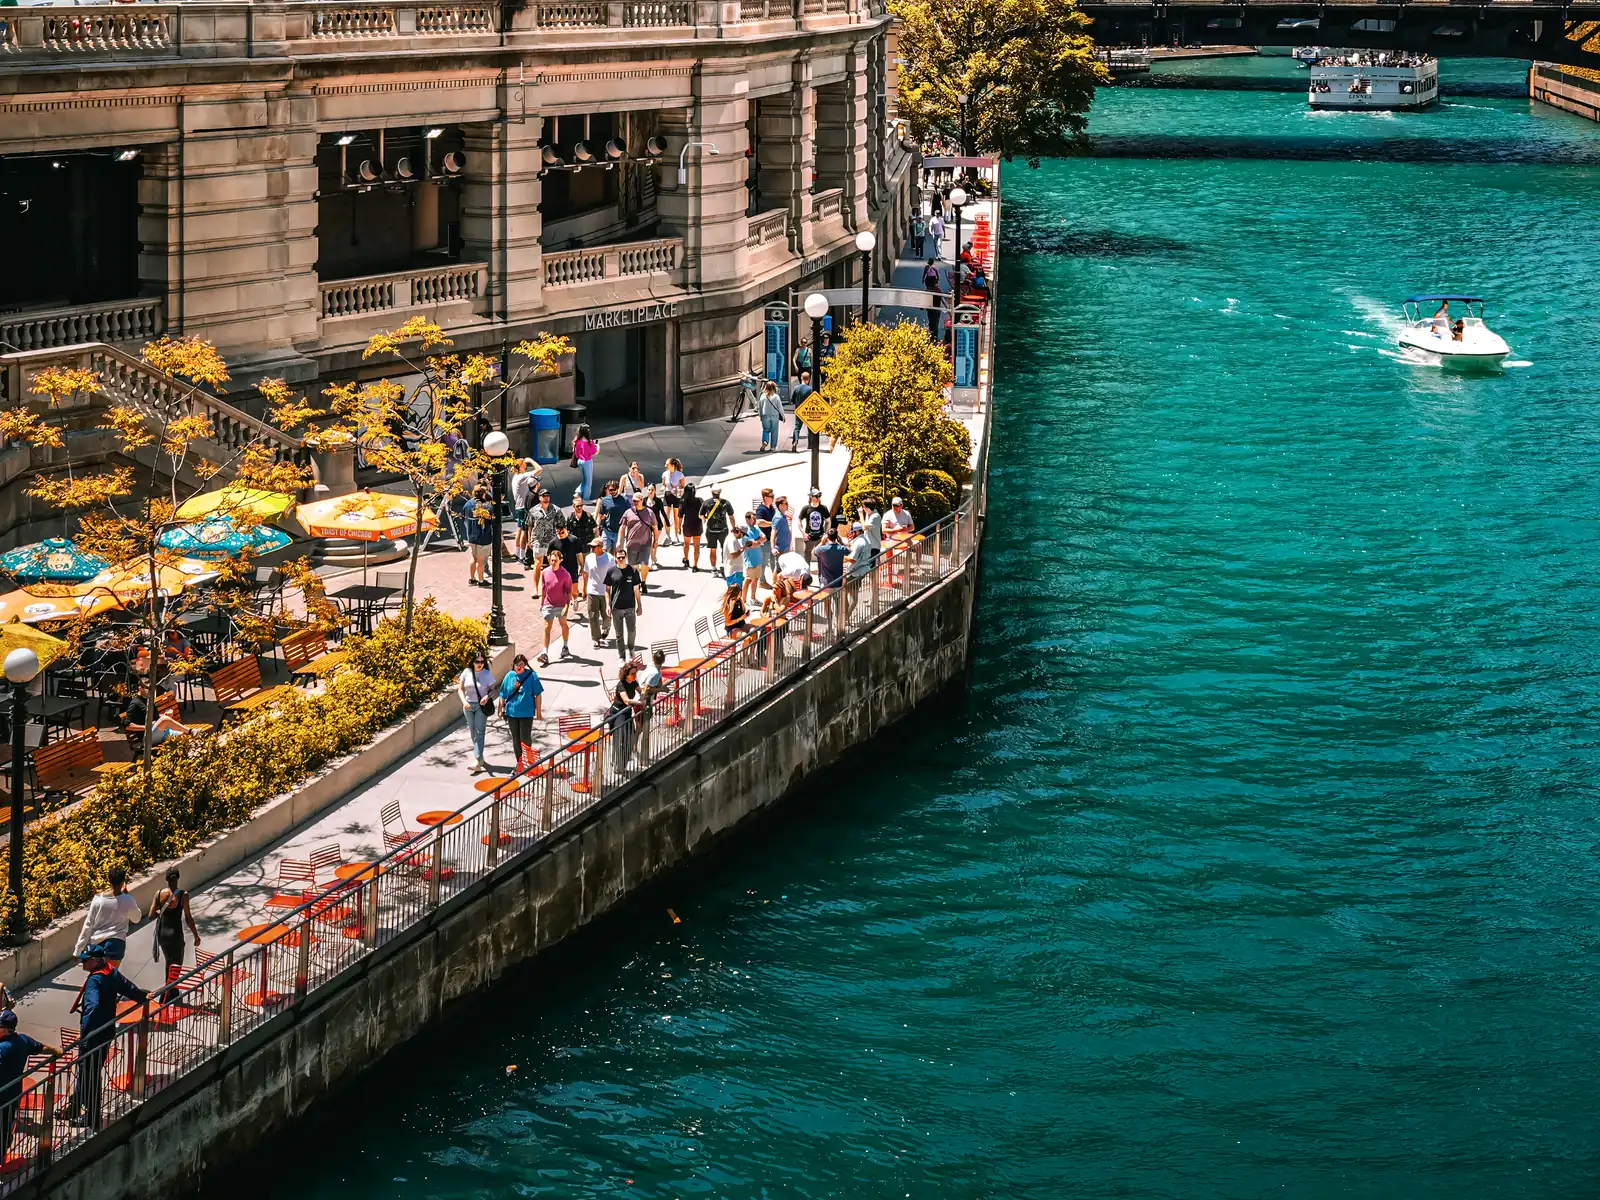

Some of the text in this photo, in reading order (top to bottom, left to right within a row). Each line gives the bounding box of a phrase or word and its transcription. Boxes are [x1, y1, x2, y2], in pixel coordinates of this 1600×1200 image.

[585, 302, 678, 331] MARKETPLACE
[320, 528, 372, 538] TOAST OF CHICAGO
